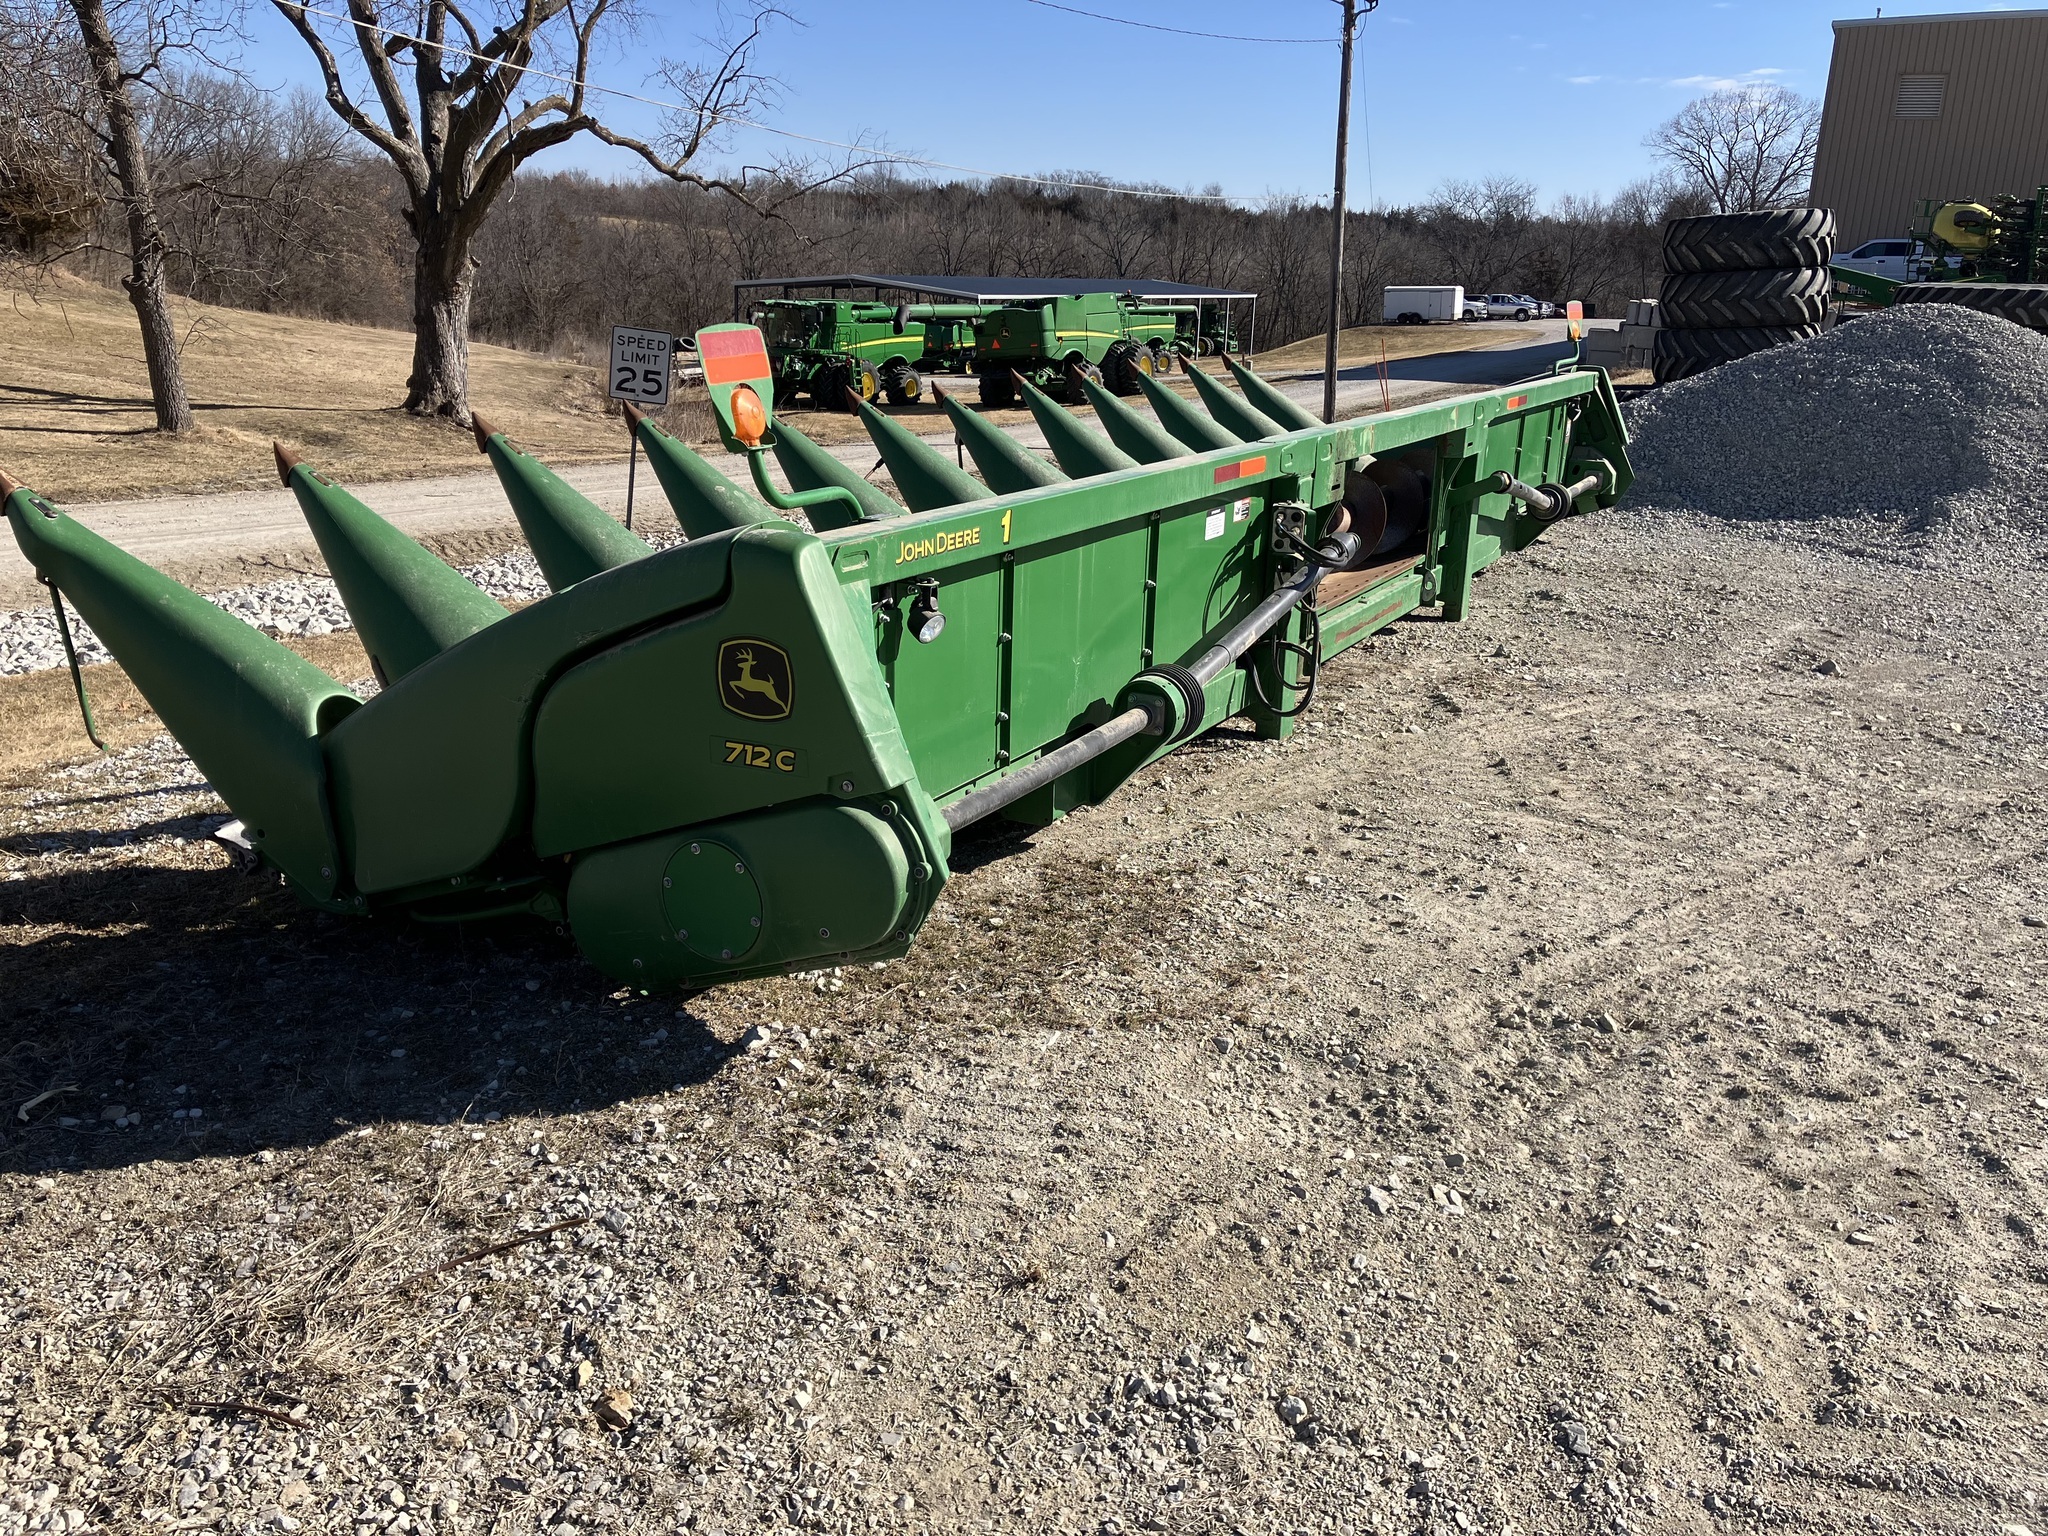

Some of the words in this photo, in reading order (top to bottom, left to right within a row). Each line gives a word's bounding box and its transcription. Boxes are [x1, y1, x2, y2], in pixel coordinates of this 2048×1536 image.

[616, 334, 667, 351] SPEED
[621, 350, 660, 365] LIMIT
[615, 366, 663, 396] 25
[1001, 509, 1013, 545] 1
[895, 538, 935, 566] JOHN
[936, 527, 981, 555] DEERE
